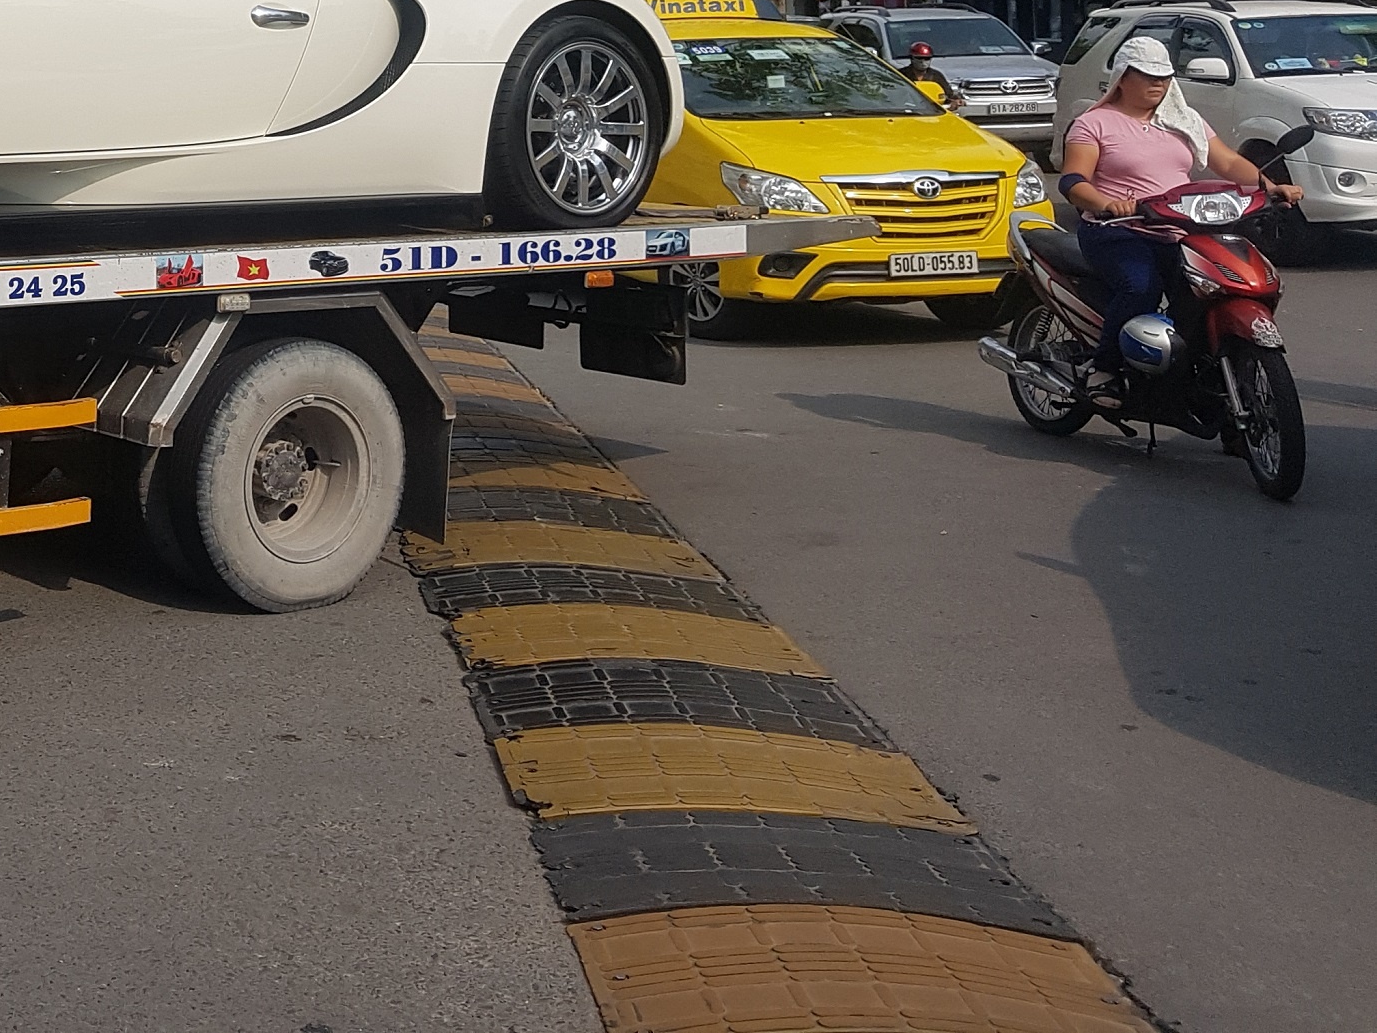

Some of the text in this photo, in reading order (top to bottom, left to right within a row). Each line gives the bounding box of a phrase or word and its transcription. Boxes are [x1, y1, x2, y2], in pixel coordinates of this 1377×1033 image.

[692, 46, 723, 55] 5039
[991, 103, 1036, 114] 51A-282.68
[379, 244, 458, 272] 51D
[497, 236, 617, 267] 166.28
[894, 253, 973, 273] 50LD-055.83
[7, 275, 43, 300] 24
[52, 272, 86, 298] 25
